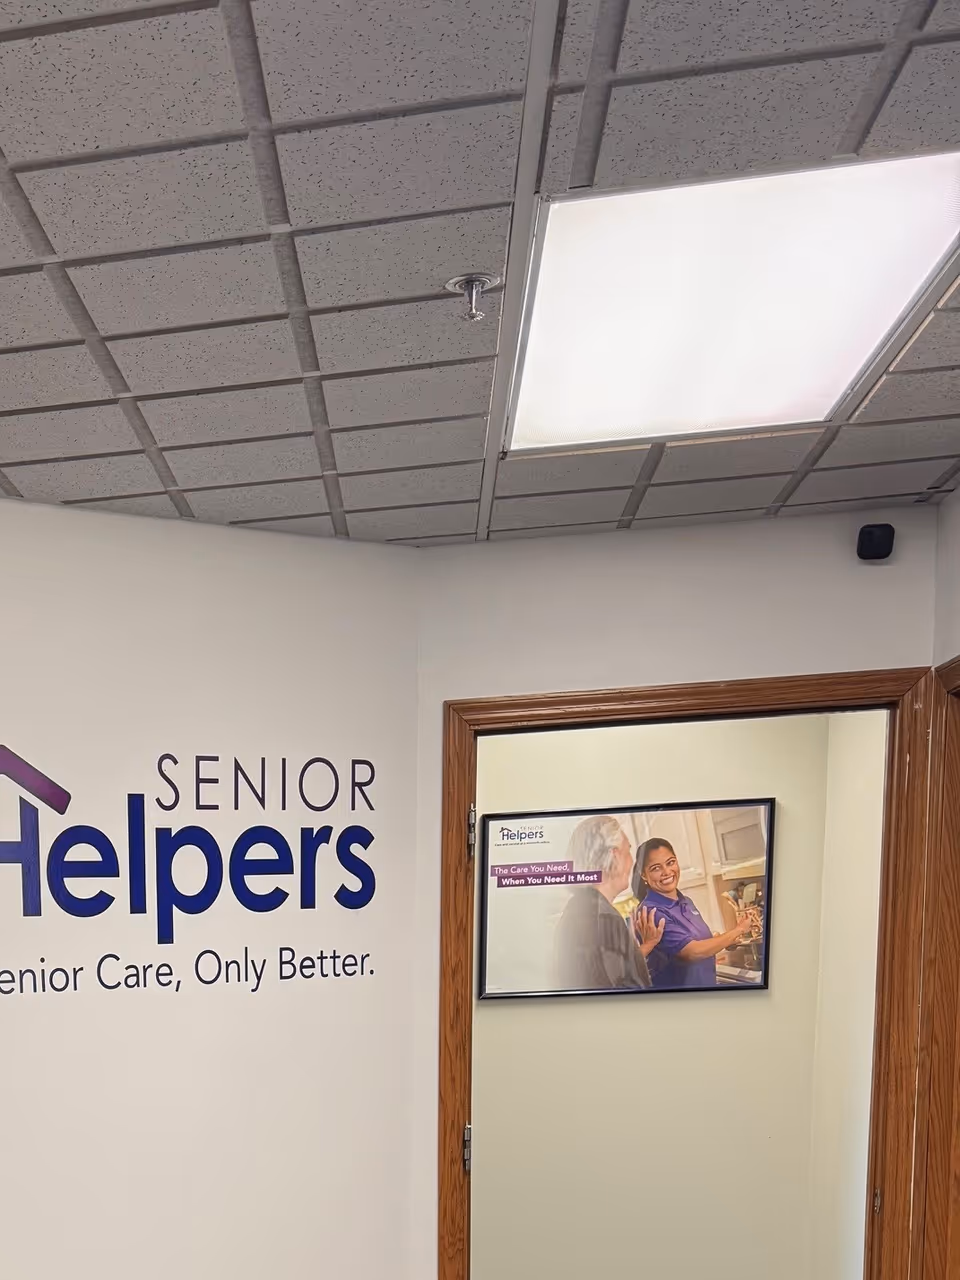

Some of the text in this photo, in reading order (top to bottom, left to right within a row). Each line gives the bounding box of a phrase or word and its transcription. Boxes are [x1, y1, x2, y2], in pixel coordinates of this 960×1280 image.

[155, 753, 376, 812] SENIOR
[501, 829, 544, 842] Helpers
[494, 863, 570, 875] The Care You Need,
[501, 873, 598, 886] When You Need It Most
[96, 953, 182, 993] Care,
[194, 946, 267, 993] Only
[278, 946, 376, 981] Better.
